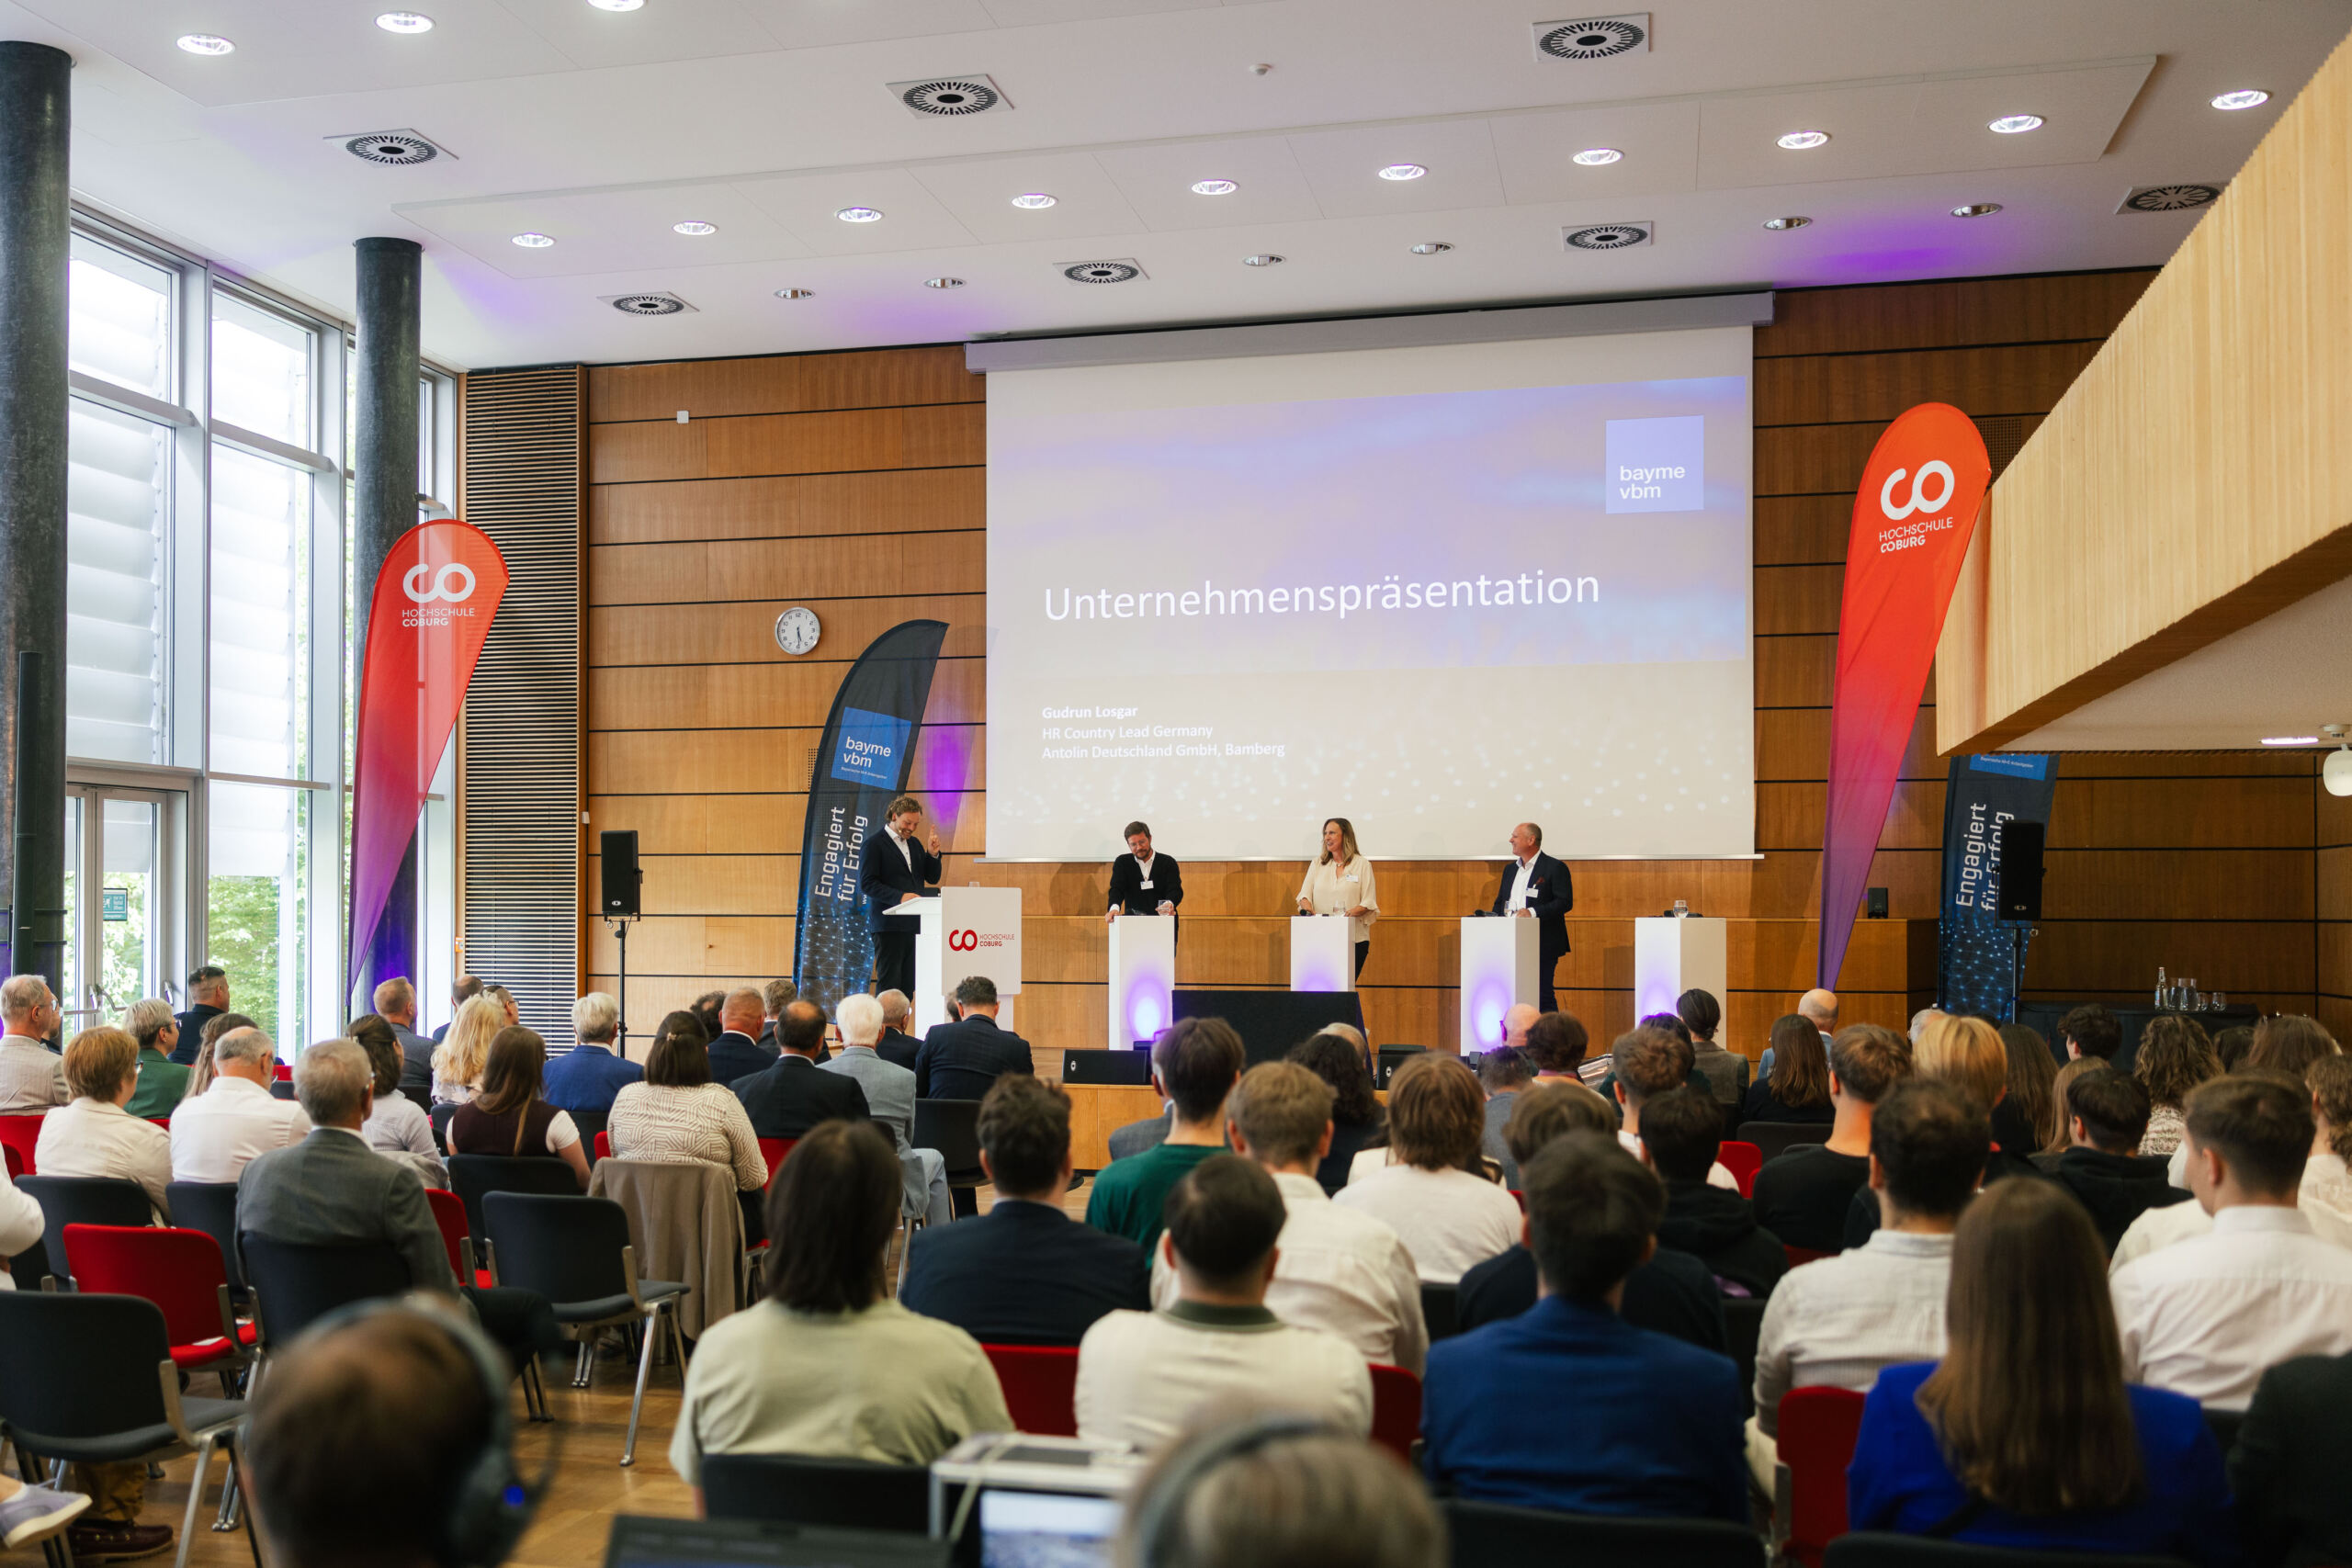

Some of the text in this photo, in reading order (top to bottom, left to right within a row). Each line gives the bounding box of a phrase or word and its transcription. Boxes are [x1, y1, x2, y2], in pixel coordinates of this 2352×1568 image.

[1620, 465, 1686, 484] bayme
[1620, 483, 1661, 499] vbm
[1879, 517, 1953, 542] HOCHSCHULE
[1881, 536, 1926, 553] COBURG
[1045, 570, 1600, 620] Unternehmenspräsentation
[402, 608, 475, 618] HOCHSCHULE
[402, 617, 448, 627] COBURG
[1042, 705, 1138, 719] Gudrun Losgar
[1043, 725, 1213, 741] HR Country Lead Germany
[845, 736, 891, 757] bayme
[1042, 743, 1286, 759] Antolin Deutschland GmbH, Bamberg
[843, 752, 872, 768] vbm
[814, 807, 845, 897] Engagiert
[837, 815, 868, 901] für Erfolg
[1955, 803, 1986, 908] Engagiert
